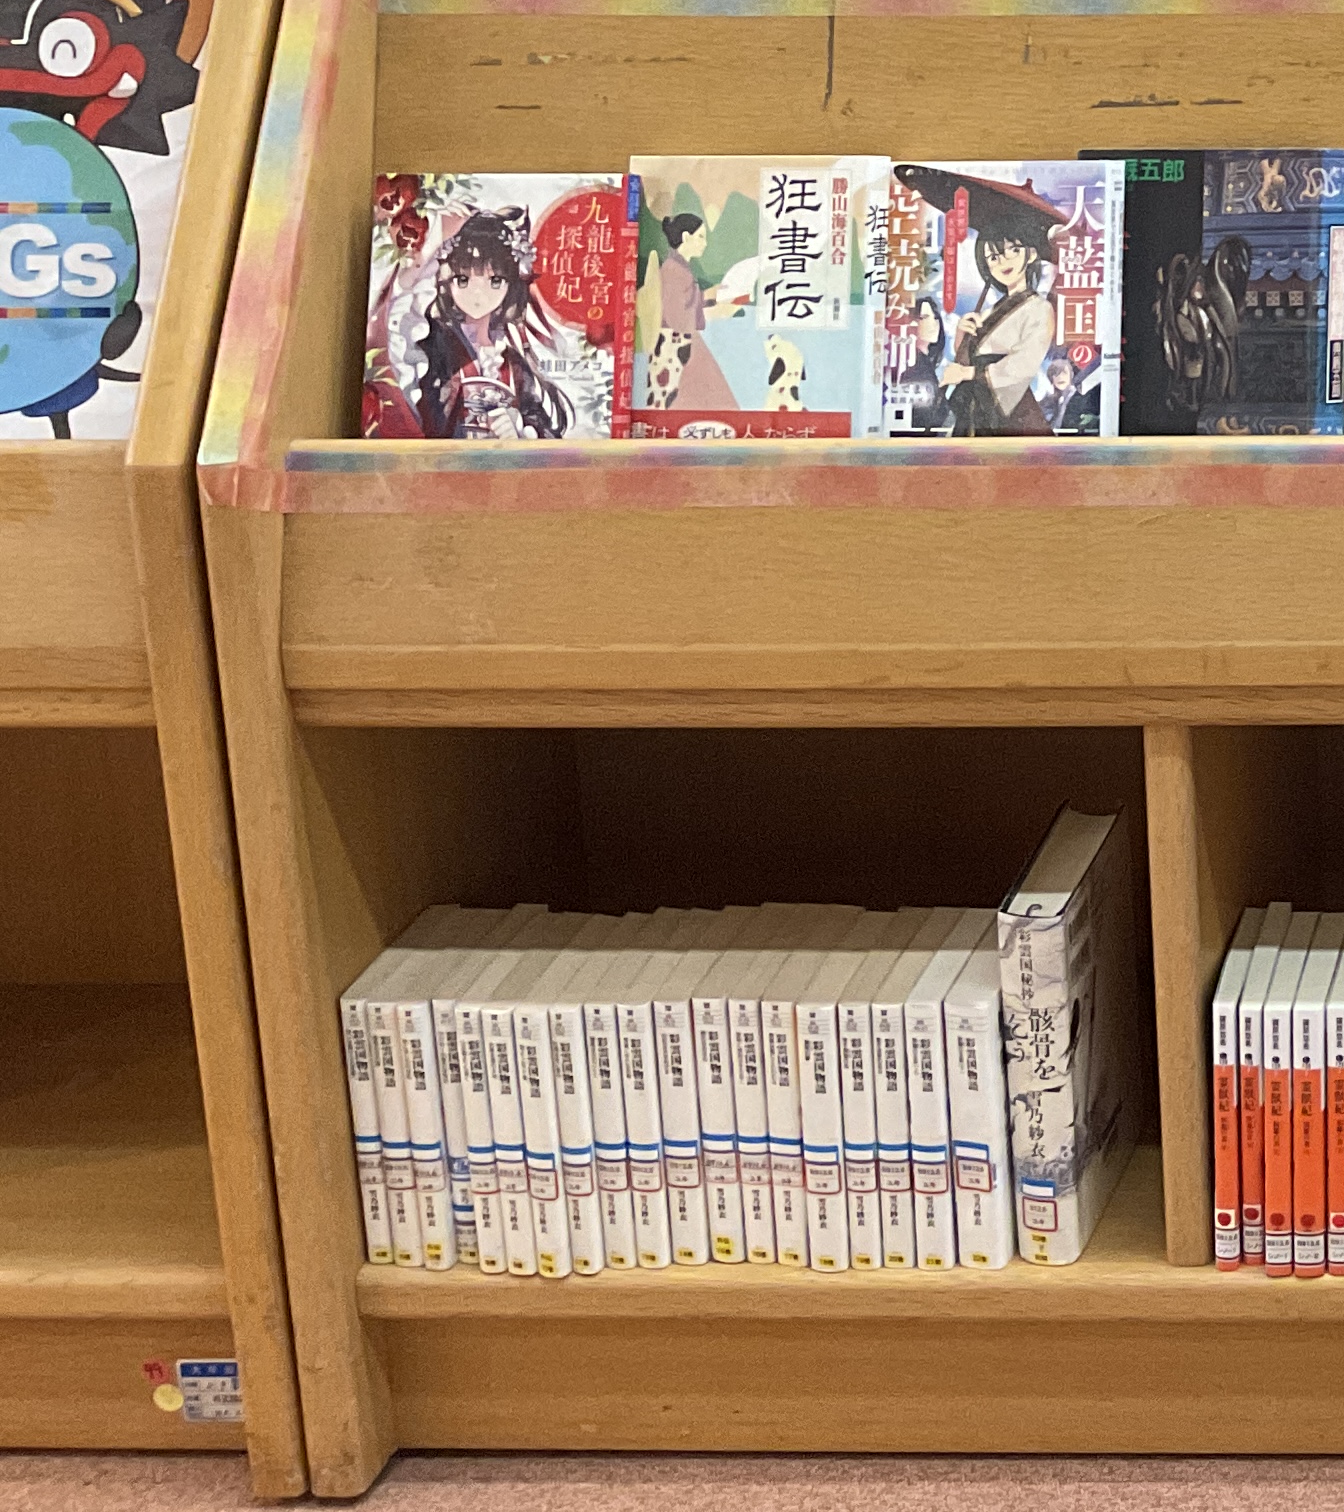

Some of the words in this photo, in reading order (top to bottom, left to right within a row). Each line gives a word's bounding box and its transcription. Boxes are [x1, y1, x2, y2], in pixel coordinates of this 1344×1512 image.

[552, 225, 584, 303] 探偵妃
[580, 197, 615, 320] 九龍後宮の
[765, 174, 825, 320] 狂書伝
[830, 177, 849, 265] 勝山海百合
[865, 205, 888, 295] 狂書伝
[1018, 928, 1035, 1001] 彩雲国秘抄
[1029, 1007, 1056, 1080] 骸骨を
